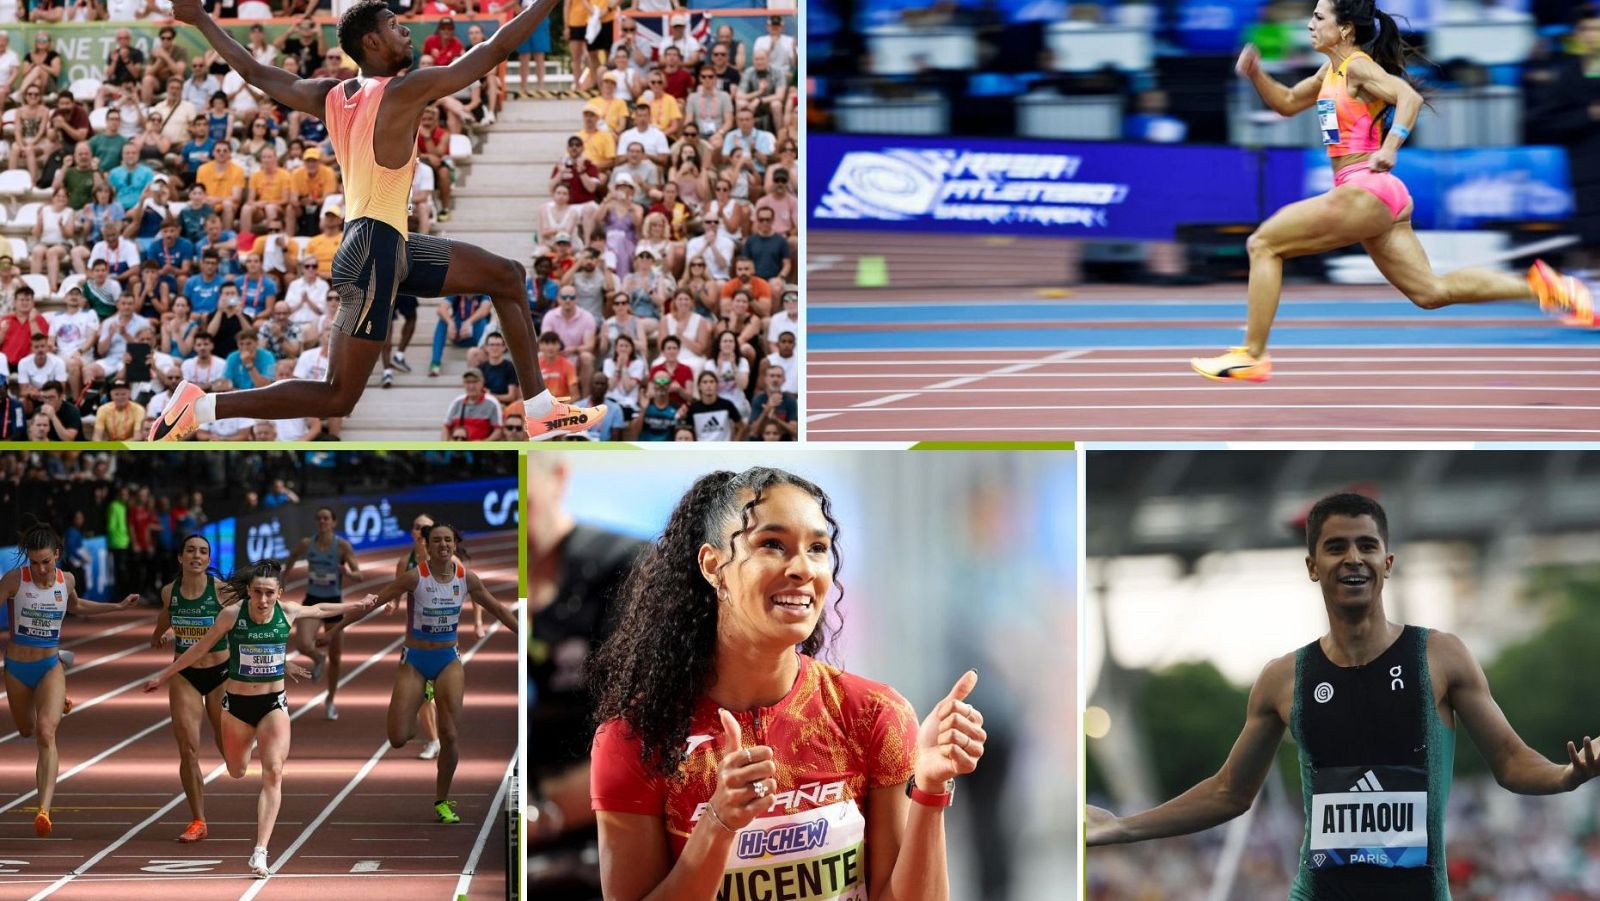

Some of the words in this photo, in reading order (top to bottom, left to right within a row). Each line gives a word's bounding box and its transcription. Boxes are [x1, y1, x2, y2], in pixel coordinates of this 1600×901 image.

[55, 37, 93, 61] NE
[543, 414, 588, 431] NITRO
[253, 656, 274, 664] SEVILLA
[690, 781, 846, 823] EAÑA
[1322, 802, 1414, 834] ATTAOUI
[1350, 854, 1388, 865] PARIS
